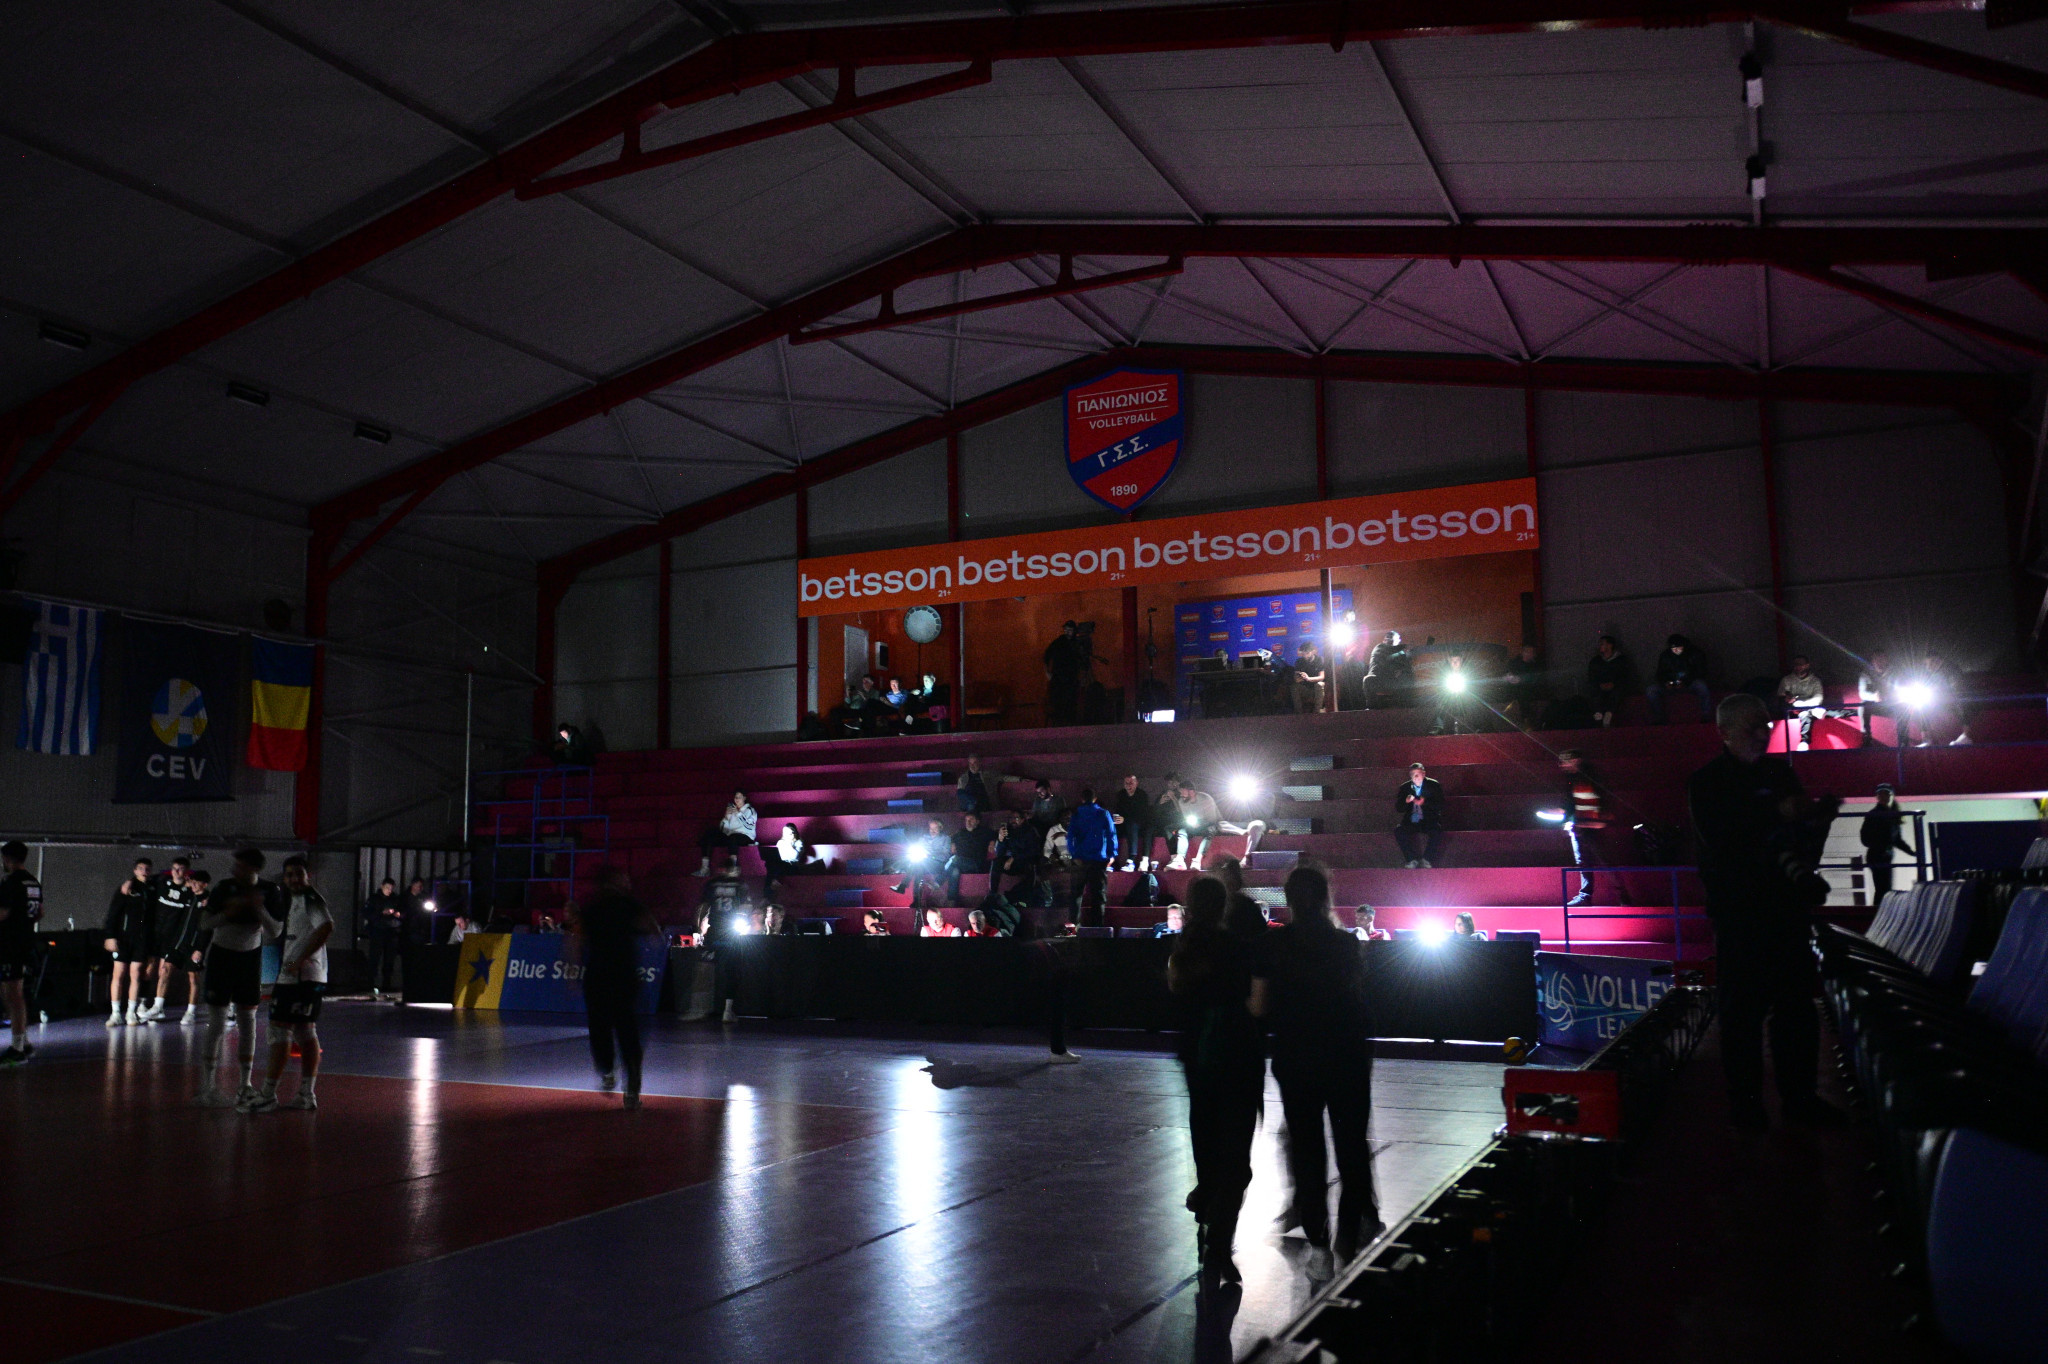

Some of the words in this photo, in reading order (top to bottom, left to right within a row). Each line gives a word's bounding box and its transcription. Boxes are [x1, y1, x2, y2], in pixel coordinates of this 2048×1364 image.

[1077, 389, 1168, 414] ΠΑΝΙΩΝΙΟΣ
[1089, 412, 1156, 430] VOLLEYBALL
[1097, 436, 1149, 468] Γ.Σ.Σ.
[1110, 484, 1138, 496] 1890
[1516, 532, 1535, 542] 21+
[801, 565, 951, 602] betsson
[958, 546, 1126, 586] betsson
[1134, 526, 1321, 569] betsson
[1325, 503, 1535, 550] betsson
[1304, 553, 1321, 562] 21+
[1110, 572, 1126, 581] 21+
[937, 589, 952, 597] 21+
[146, 753, 207, 780] CEV
[508, 959, 547, 979] Blue
[552, 960, 586, 980] Star
